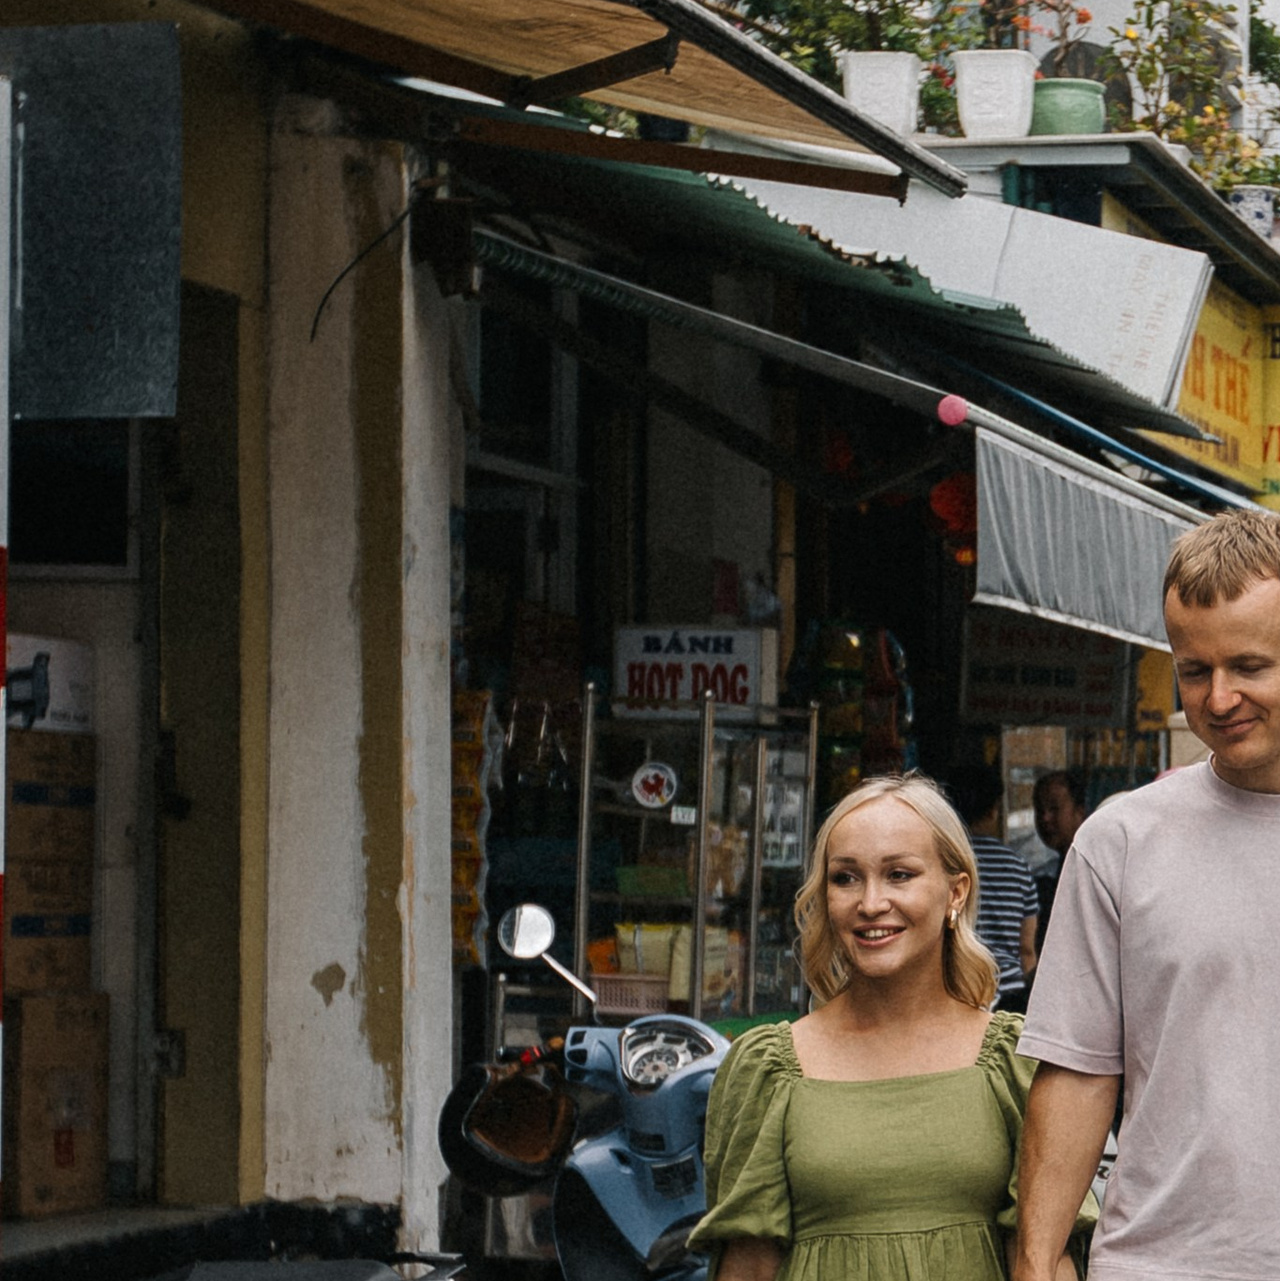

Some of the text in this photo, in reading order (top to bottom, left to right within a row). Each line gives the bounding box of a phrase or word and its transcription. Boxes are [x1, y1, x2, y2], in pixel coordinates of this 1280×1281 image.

[643, 631, 734, 654] BÁNH
[626, 661, 750, 711] HOT DOG
